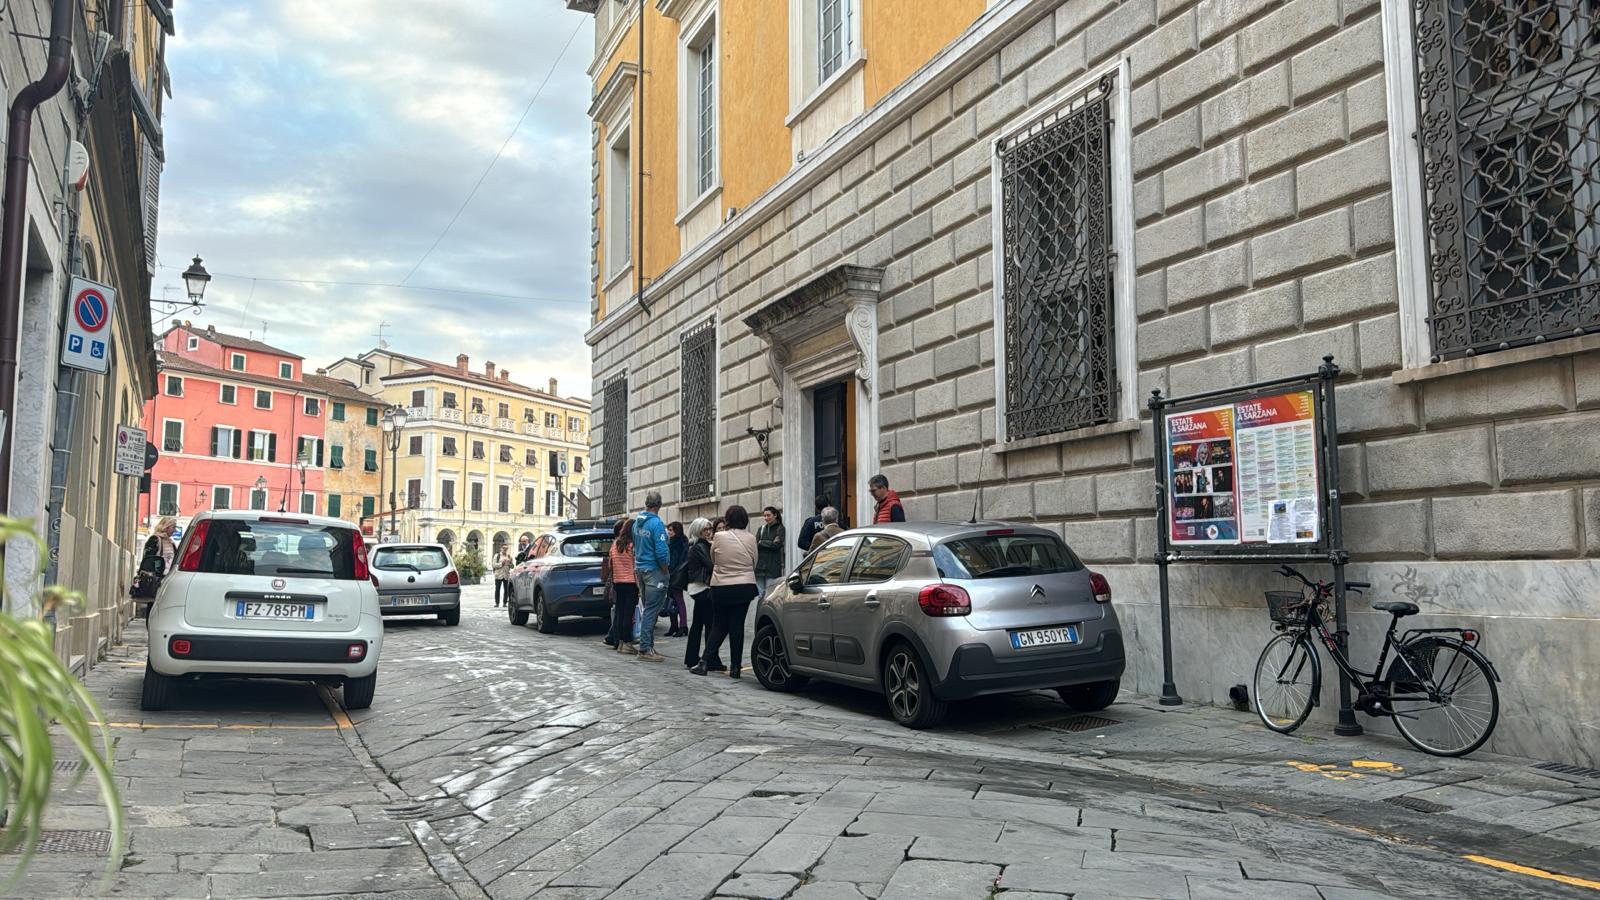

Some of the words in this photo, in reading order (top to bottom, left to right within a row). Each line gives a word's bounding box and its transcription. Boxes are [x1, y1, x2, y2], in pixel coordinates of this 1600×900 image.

[71, 336, 80, 350] P
[1237, 403, 1262, 414] ESTATE
[1243, 408, 1278, 420] SARZANA
[1171, 416, 1194, 427] ESTATE
[1177, 422, 1208, 433] SARZANA
